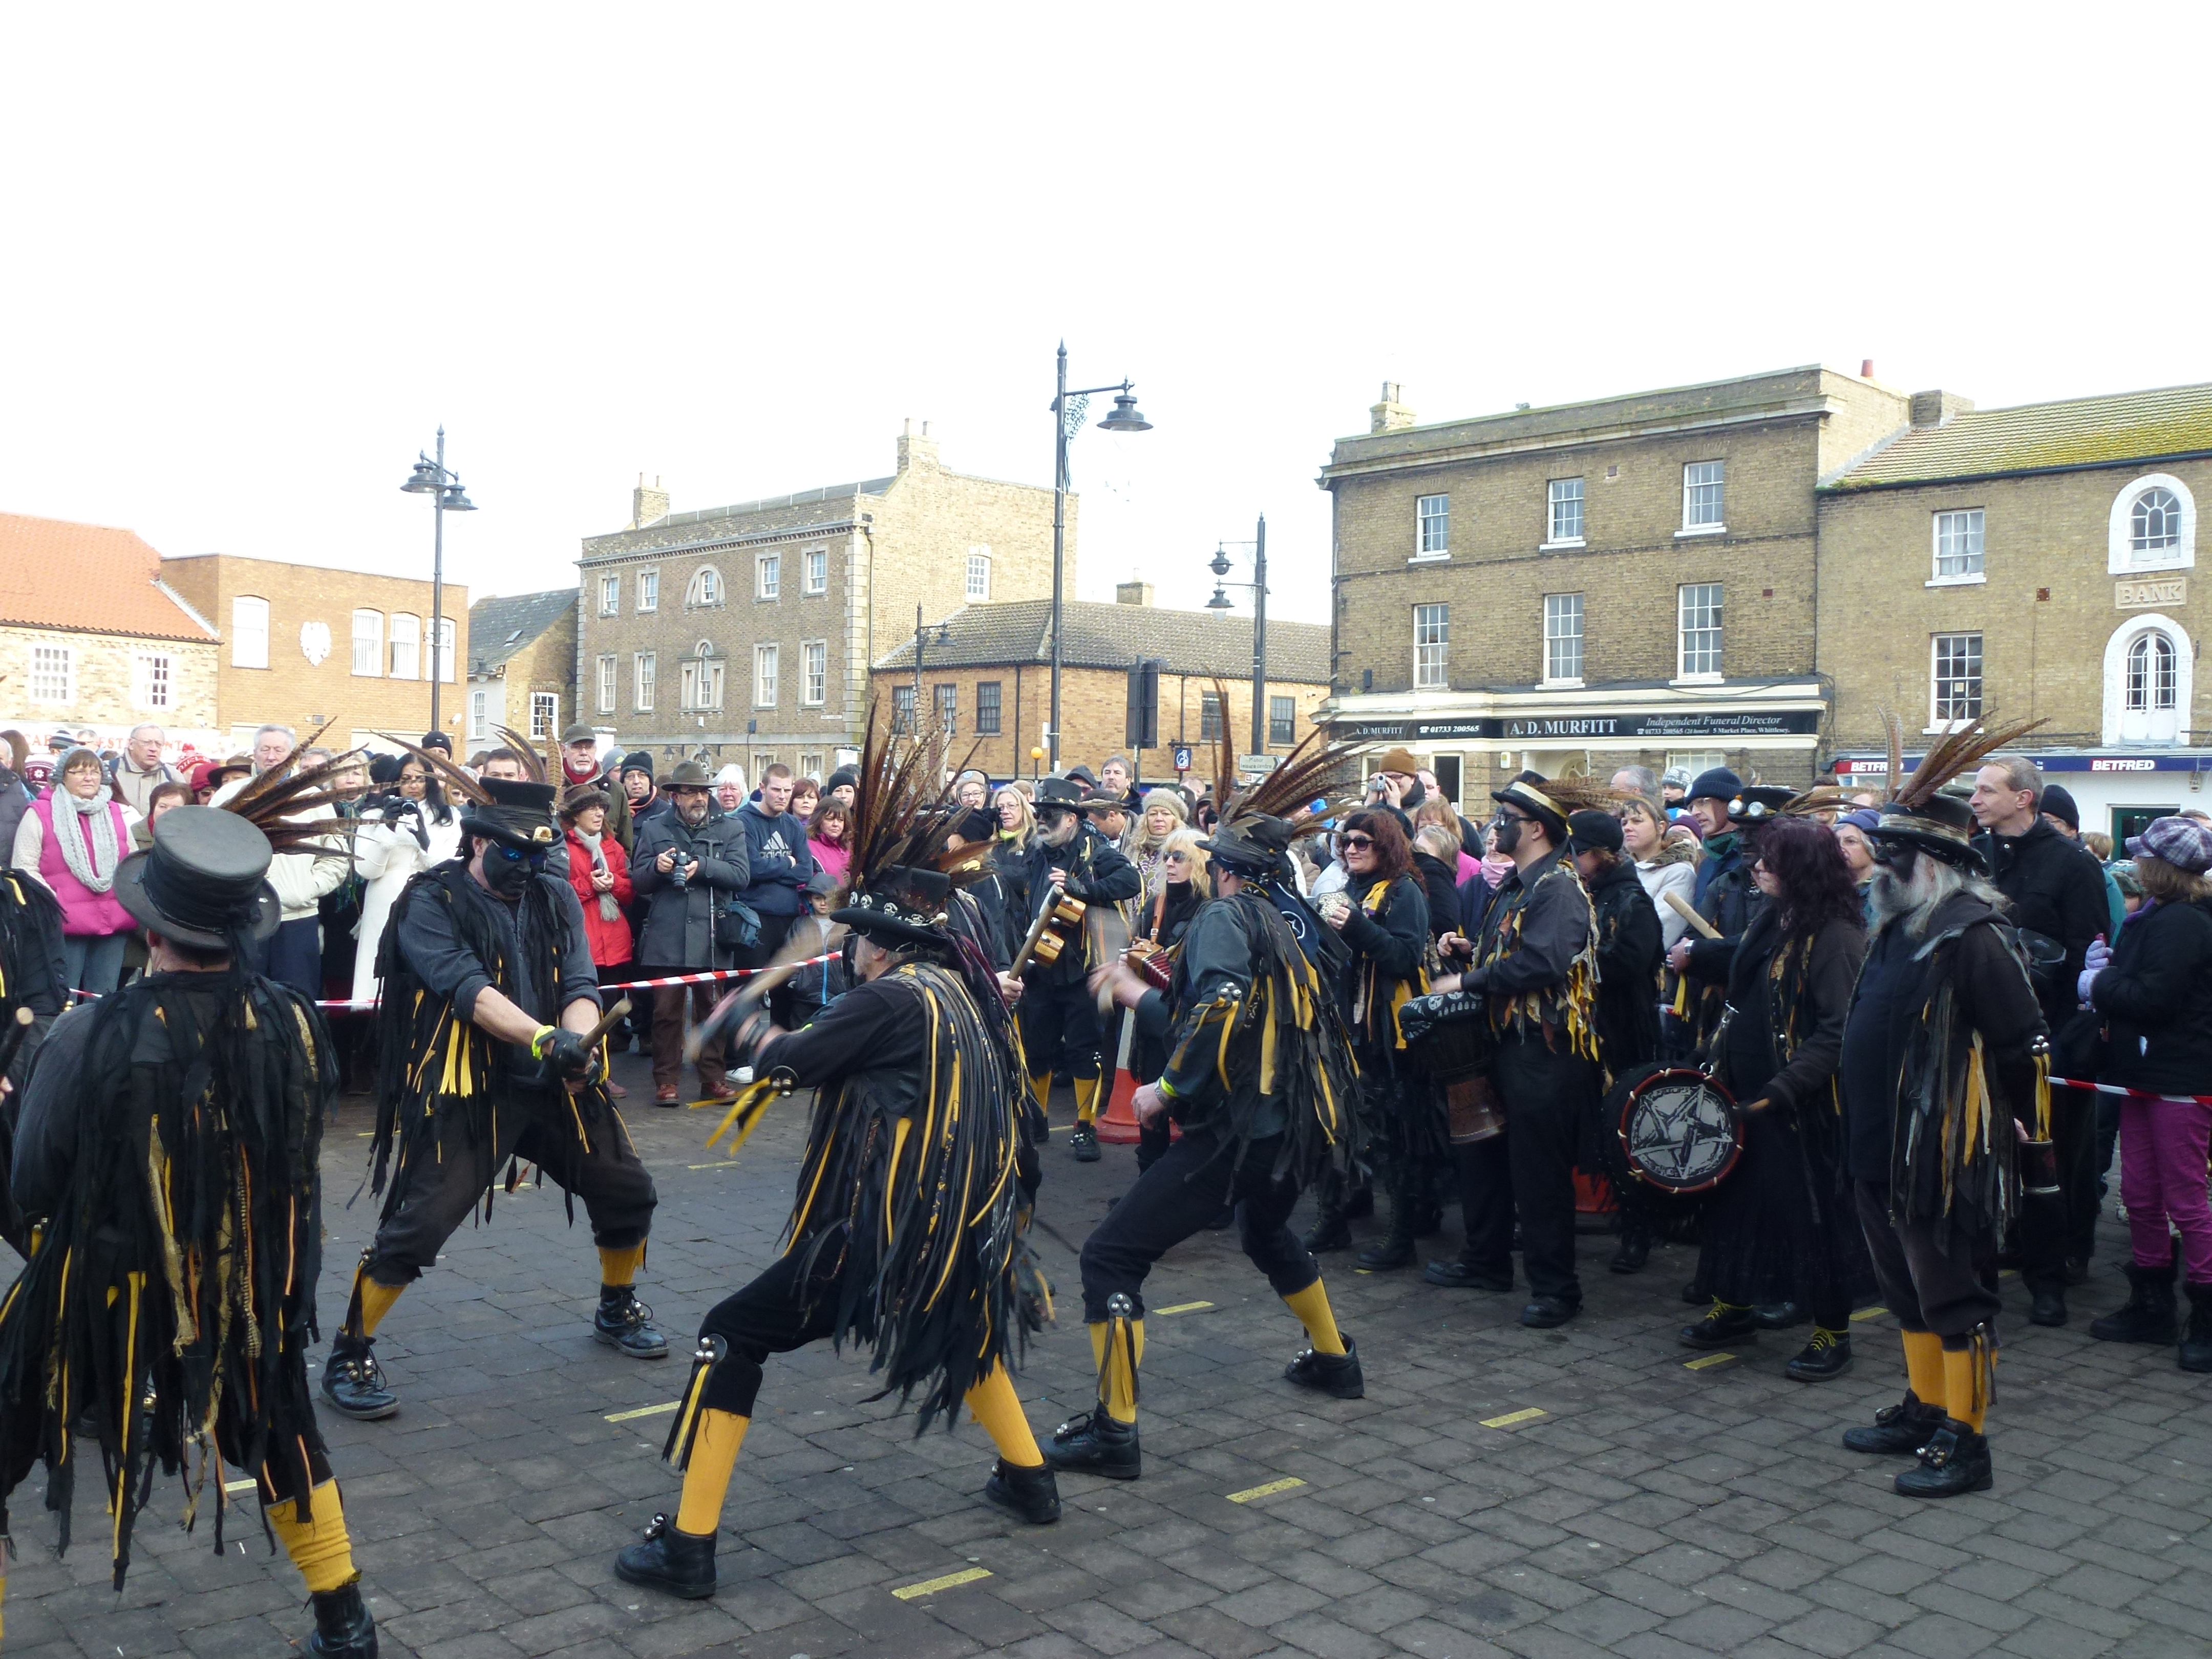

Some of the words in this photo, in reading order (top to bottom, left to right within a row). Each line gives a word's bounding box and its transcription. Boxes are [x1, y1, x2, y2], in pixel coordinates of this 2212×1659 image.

[2119, 583, 2181, 604] BANK
[1511, 722, 1524, 734] A.
[1527, 721, 1541, 734] D.
[1544, 719, 1617, 734] MURFITT
[1646, 717, 1700, 728] Independent
[1703, 716, 1741, 725] Funeral
[1741, 715, 1782, 725] Director
[1851, 761, 1904, 772] BETFR
[2092, 759, 2155, 771] BETFRED
